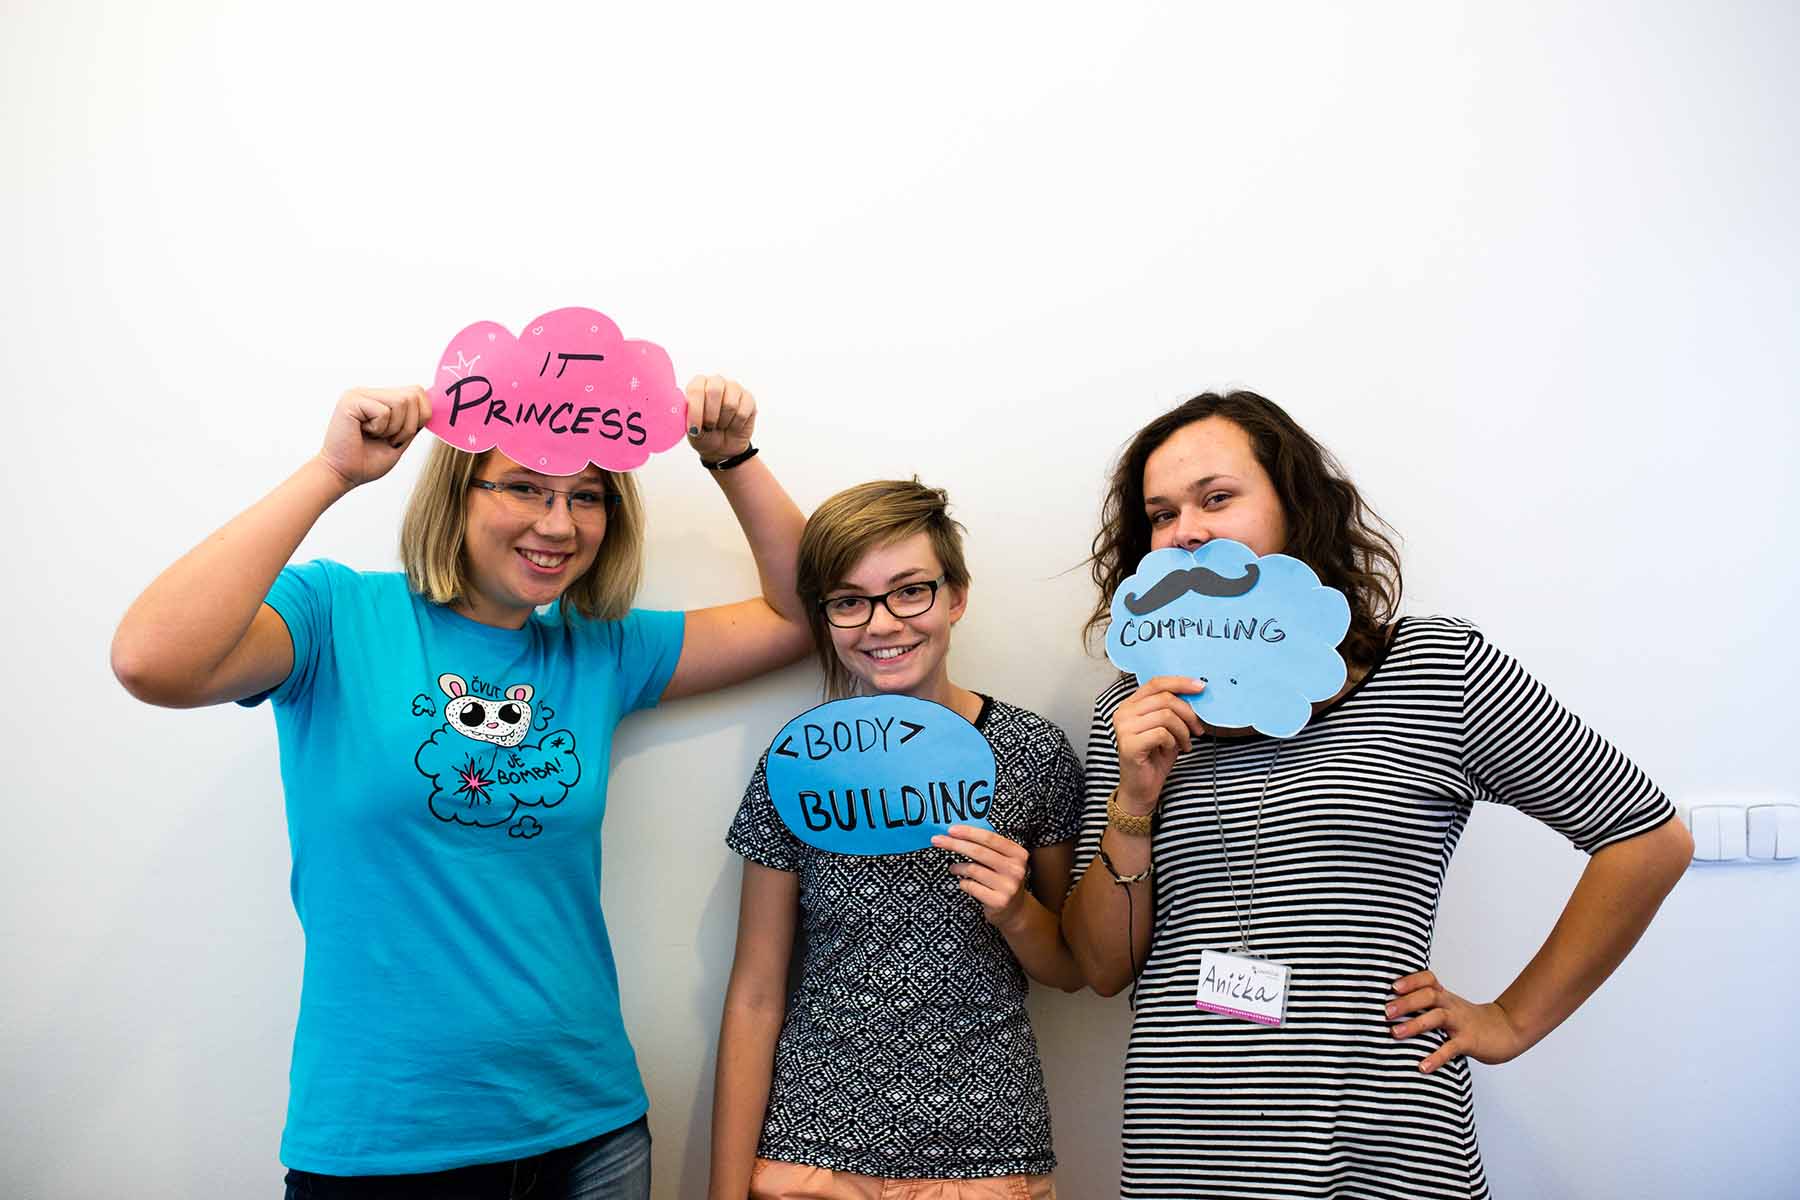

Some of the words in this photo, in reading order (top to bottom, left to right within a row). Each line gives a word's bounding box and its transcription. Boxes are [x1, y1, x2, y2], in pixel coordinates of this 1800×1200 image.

[539, 351, 604, 379] IT
[446, 375, 647, 446] PRINCESS
[1119, 616, 1287, 647] COMPILING
[471, 675, 502, 699] ČVUT
[497, 757, 565, 785] BOMBA!
[507, 753, 526, 769] JE
[798, 779, 992, 832] BUILDING
[1202, 965, 1280, 1002] Anička
